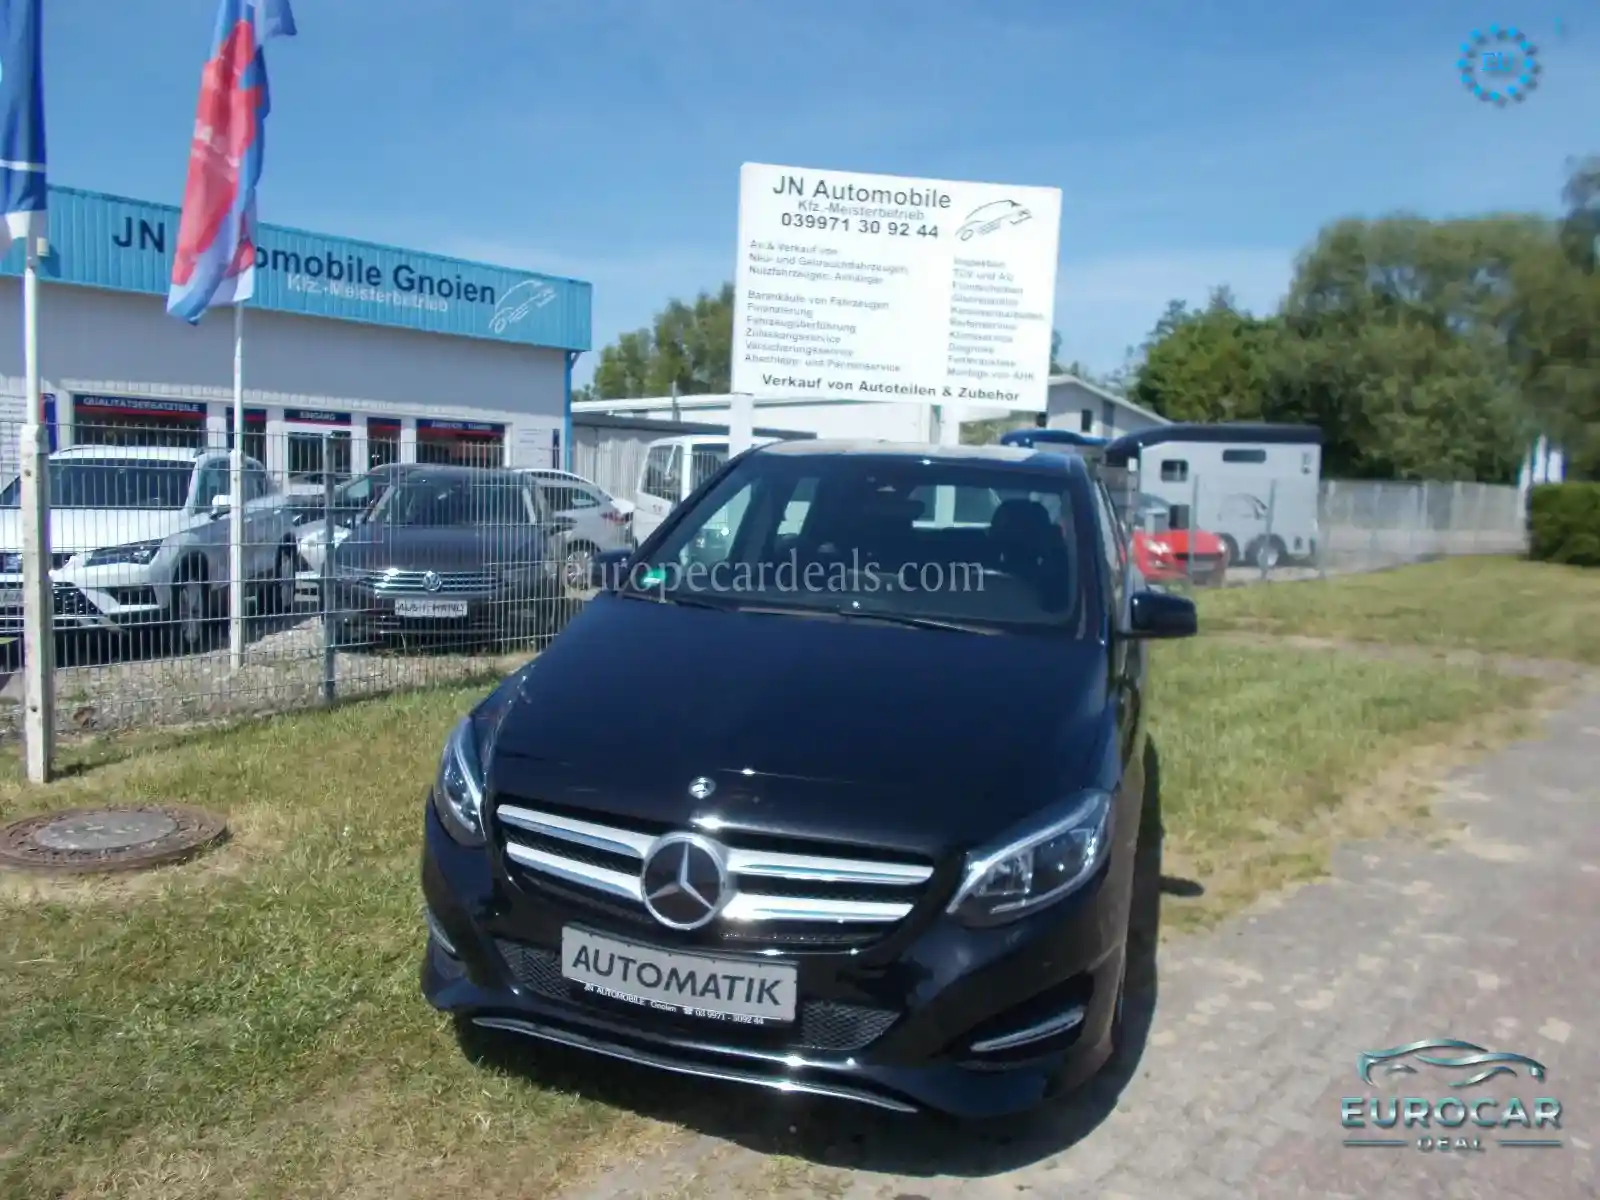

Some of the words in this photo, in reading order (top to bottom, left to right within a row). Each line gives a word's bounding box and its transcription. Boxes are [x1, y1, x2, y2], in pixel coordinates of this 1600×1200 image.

[772, 175, 804, 197] JN
[812, 179, 952, 209] Automobile
[781, 212, 850, 232] 039971
[858, 219, 881, 234] 30
[887, 222, 910, 237] 92
[915, 224, 940, 239] 44
[111, 216, 165, 253] JN
[254, 246, 382, 287] omobile
[392, 264, 496, 305] Gnoien
[776, 255, 796, 265] und
[808, 297, 828, 306] von
[761, 373, 823, 390] Verkauf
[828, 381, 854, 392] von
[859, 380, 937, 397] Autoteilen
[941, 386, 953, 397] &
[571, 944, 785, 1007] AUTOMATIK
[596, 986, 647, 1007] AUTOMOBILE
